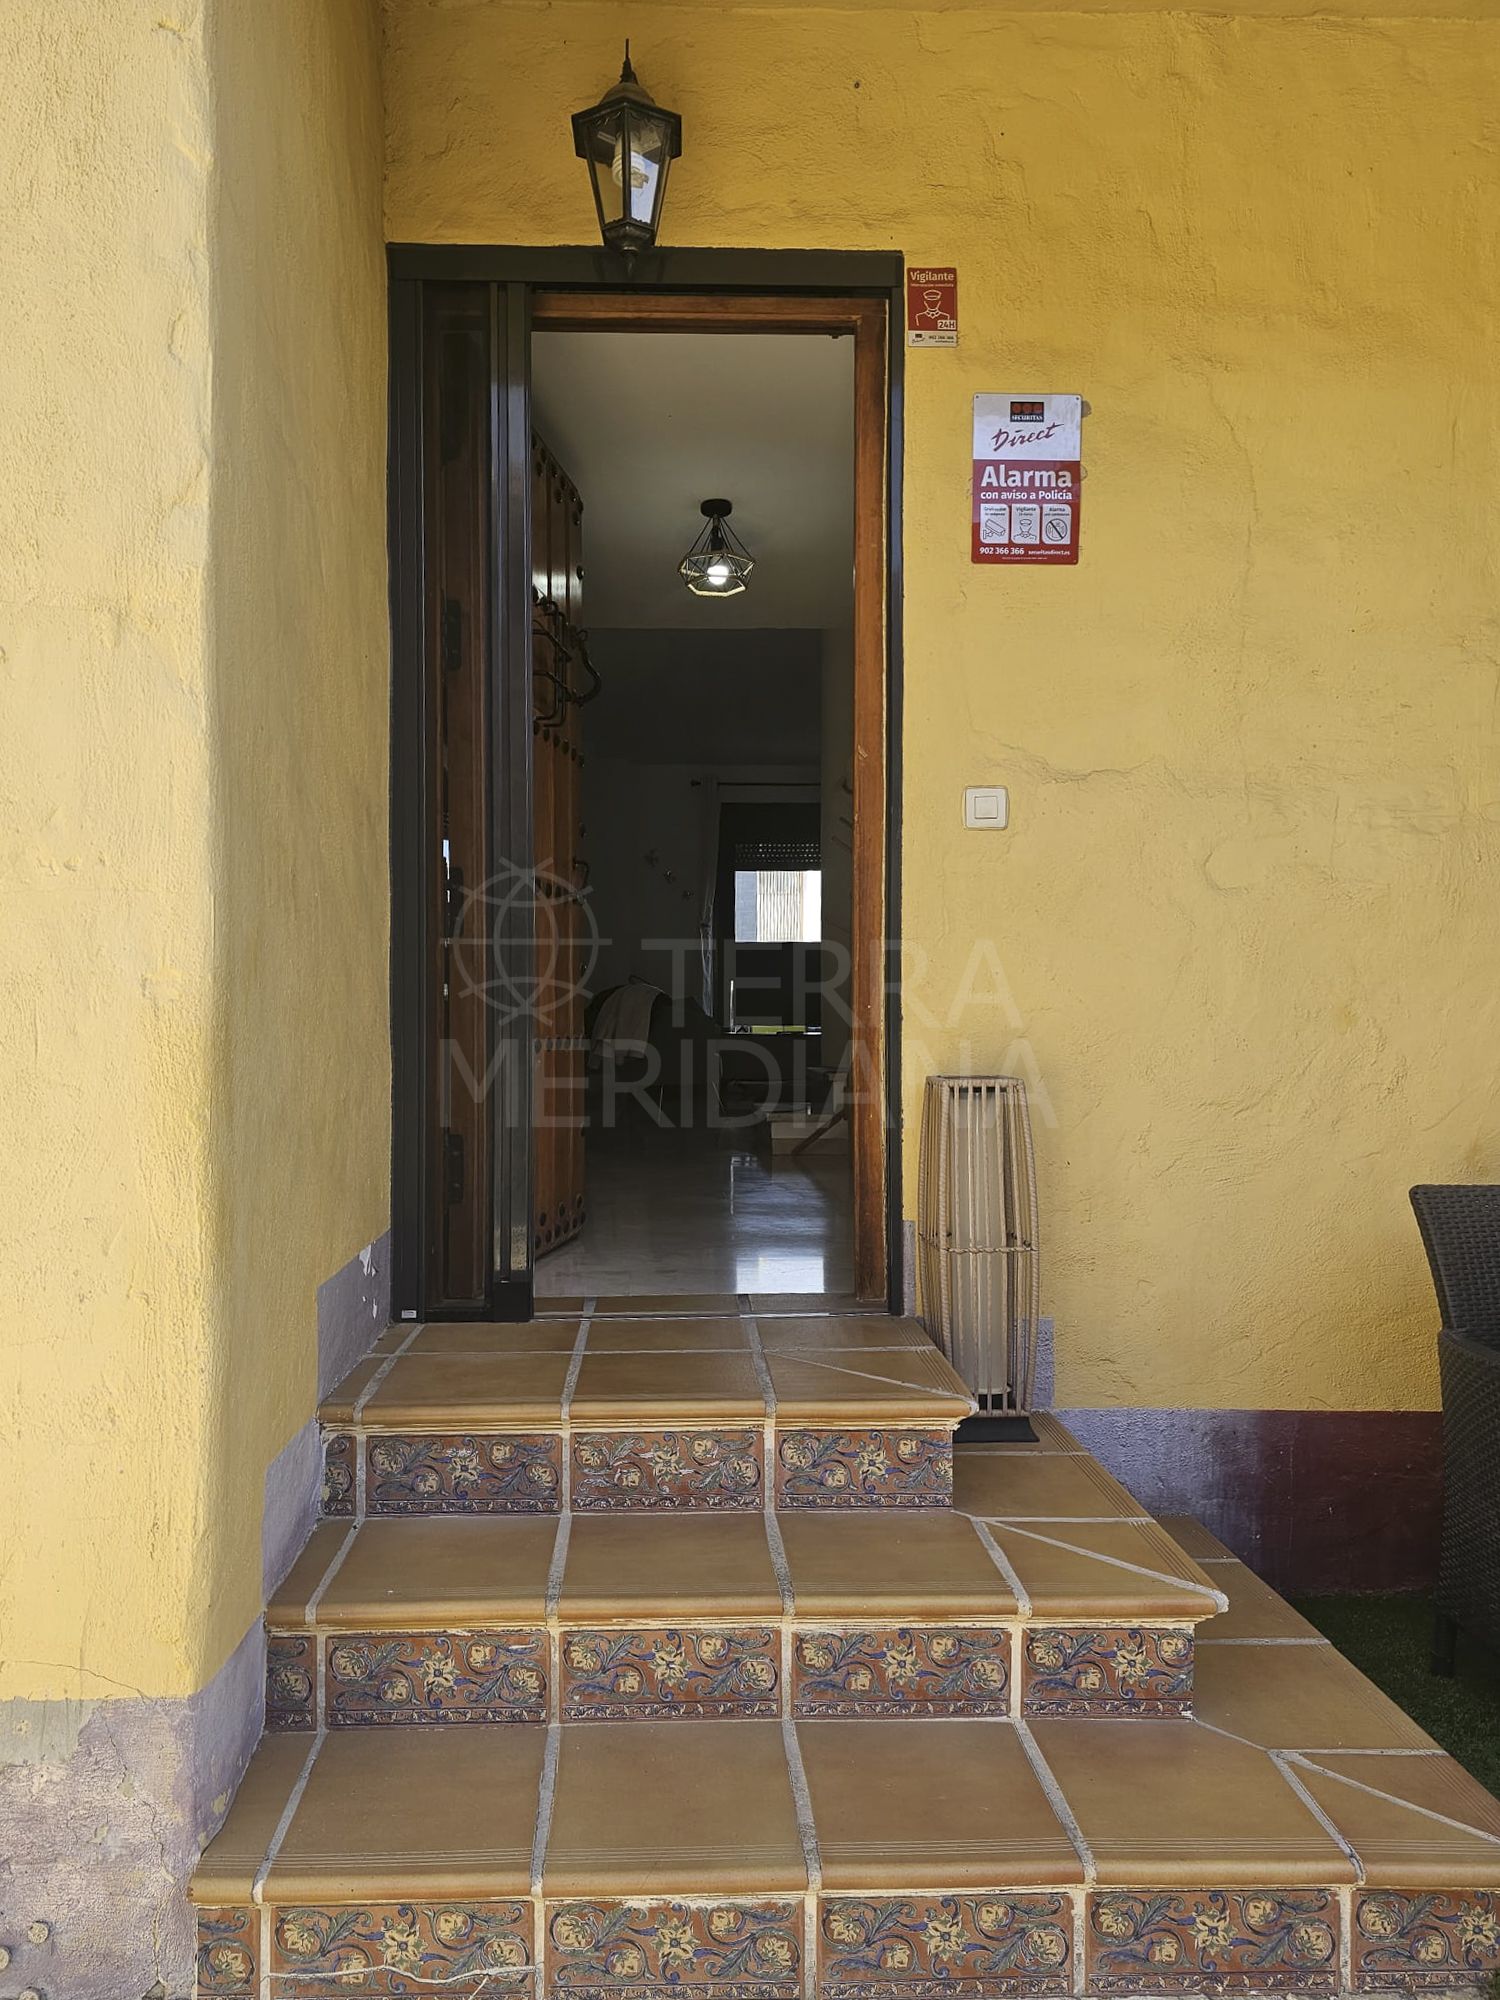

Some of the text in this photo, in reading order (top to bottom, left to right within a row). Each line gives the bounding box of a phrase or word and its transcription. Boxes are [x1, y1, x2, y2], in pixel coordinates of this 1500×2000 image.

[910, 271, 954, 283] Vigilante
[991, 422, 1064, 452] Direct
[981, 464, 1072, 487] Alarma
[980, 491, 998, 499] con
[1001, 490, 1027, 499] aviso
[1039, 490, 1072, 500] Policía
[979, 547, 993, 555] 902
